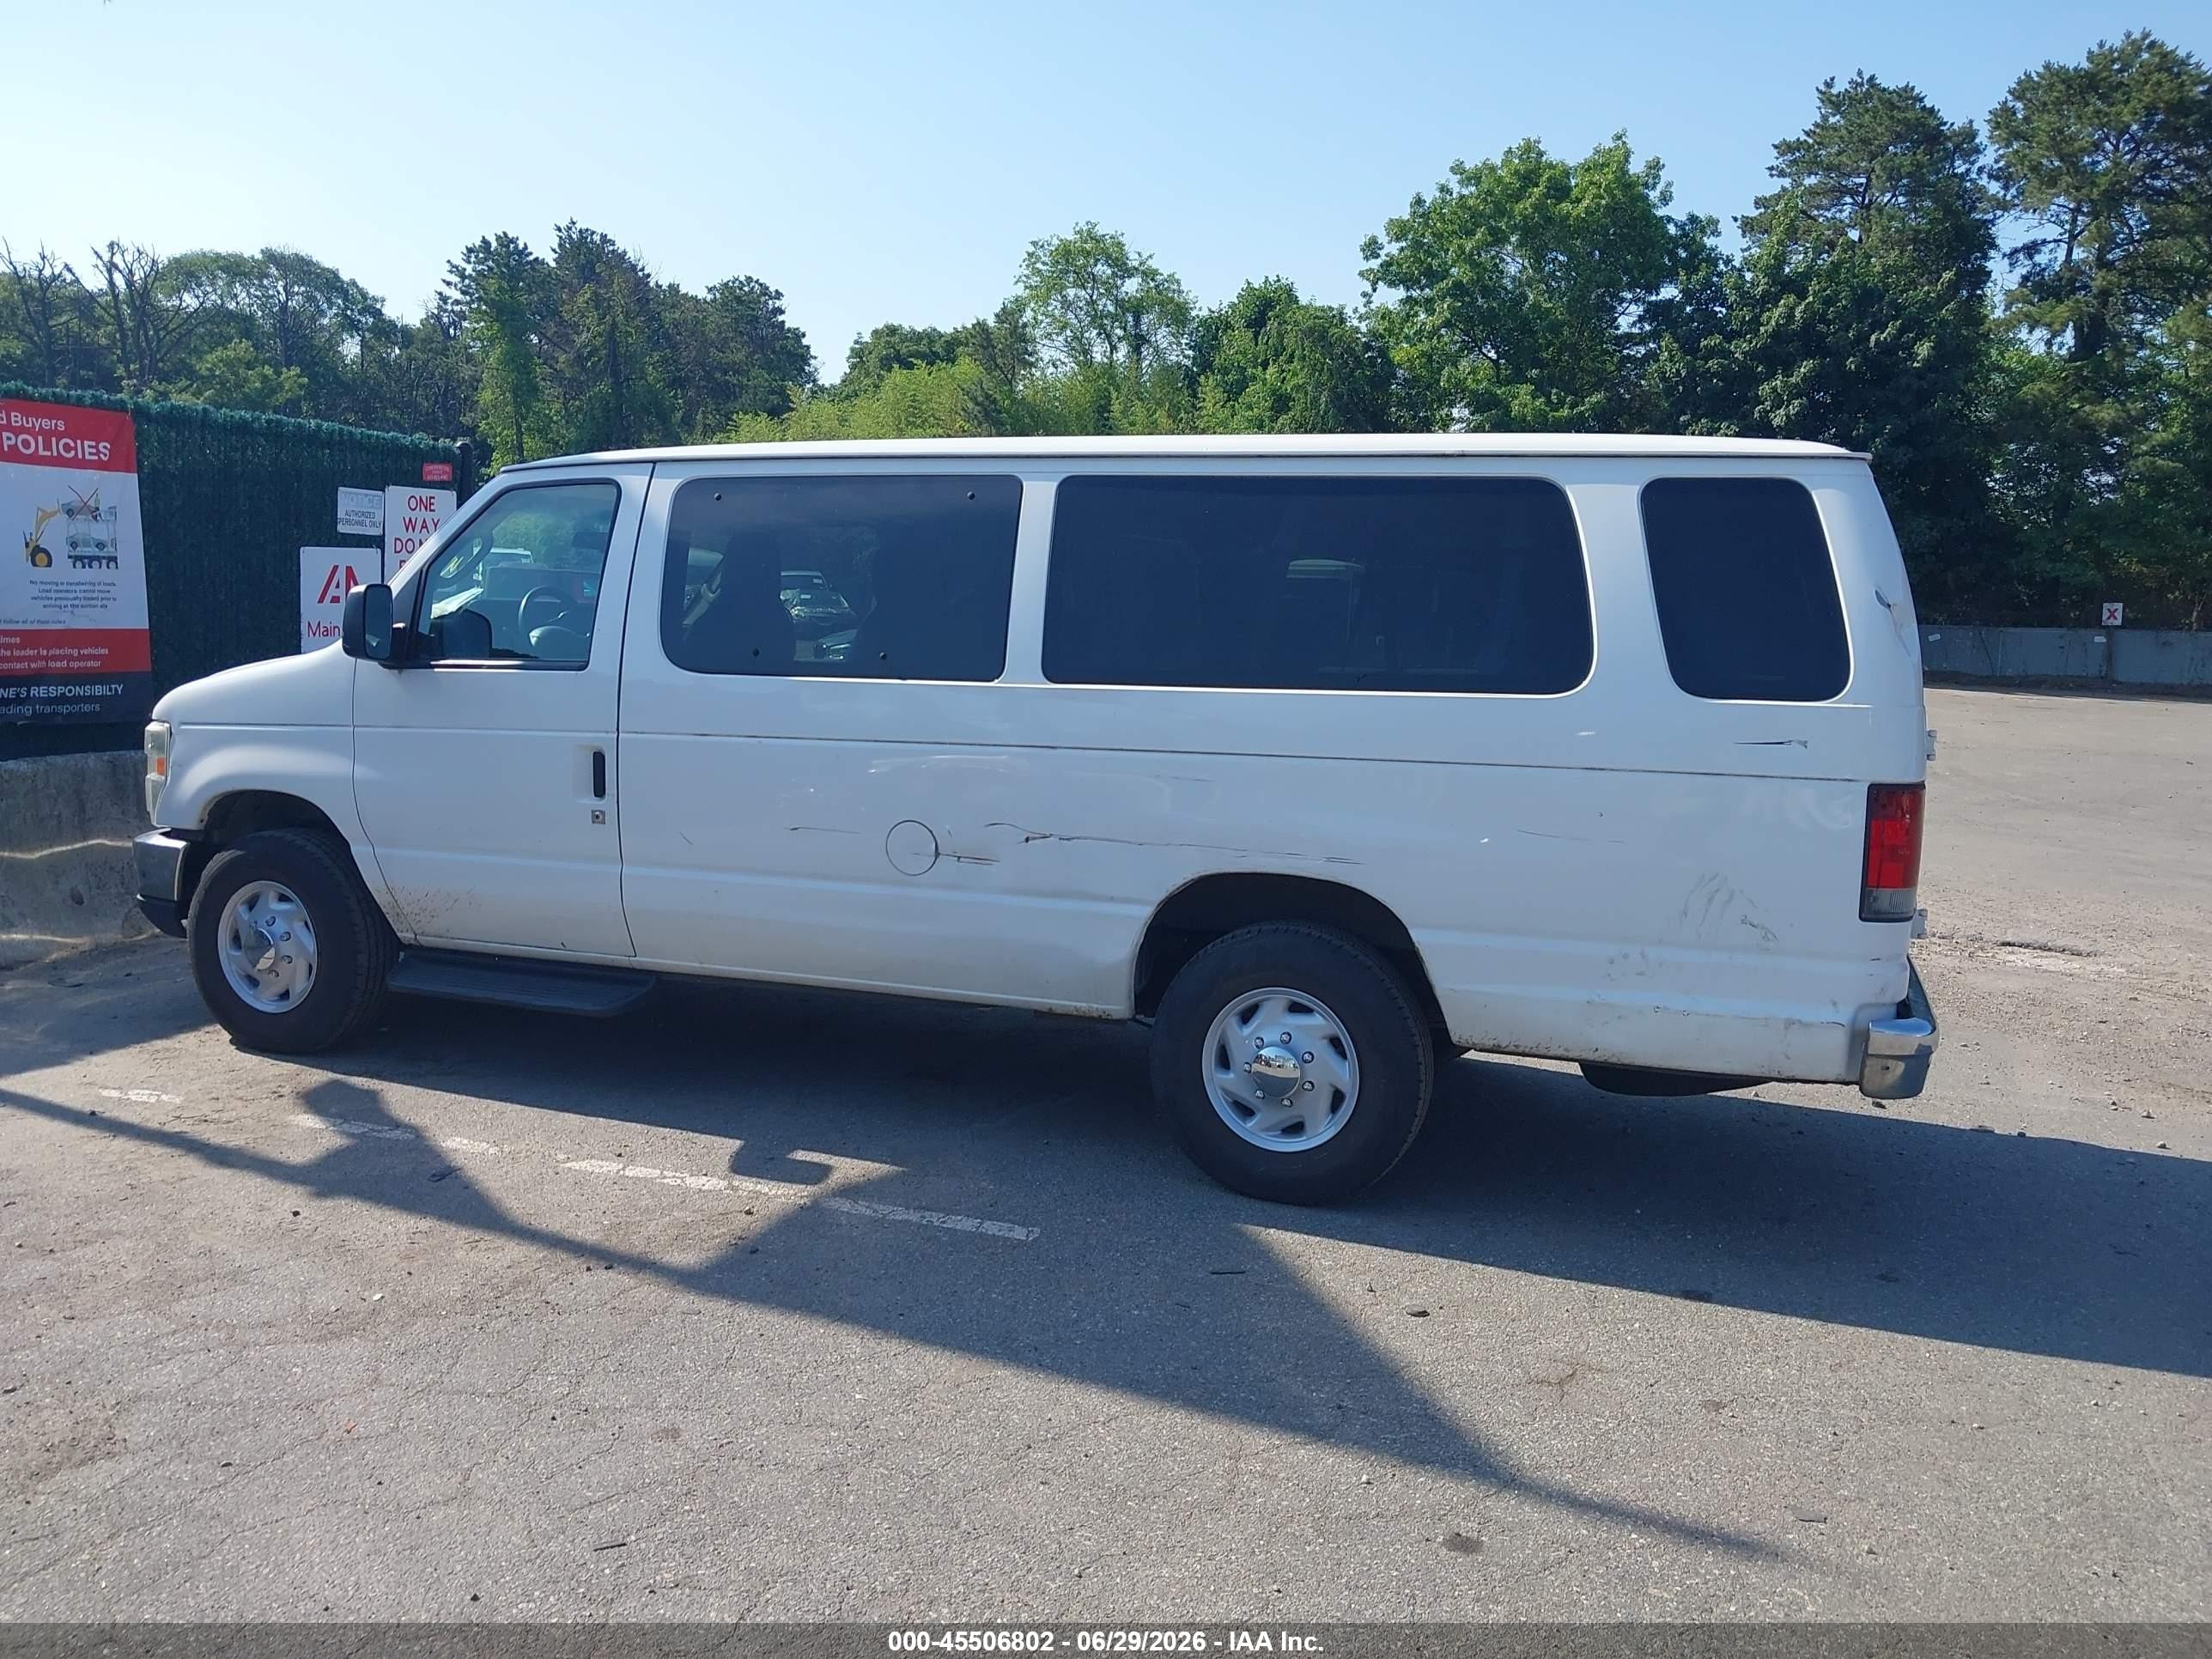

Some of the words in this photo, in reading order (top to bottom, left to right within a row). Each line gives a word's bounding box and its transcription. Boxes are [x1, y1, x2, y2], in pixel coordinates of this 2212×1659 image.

[10, 411, 66, 432] Buyers
[2, 431, 112, 461] POLICIES
[340, 493, 380, 508] NOTICE
[407, 495, 436, 513] ONE
[344, 508, 376, 520] AUTHORIZED
[337, 517, 368, 528] PERSONNEL
[369, 520, 382, 529] ONLY
[402, 516, 441, 534] WAY
[307, 620, 341, 638] Main
[0, 635, 21, 644] imes
[0, 647, 12, 658] he
[13, 647, 38, 657] loader
[40, 647, 48, 656] is
[48, 647, 78, 658] placing
[80, 646, 109, 655] vehicles
[0, 660, 28, 670] contact
[29, 659, 46, 669] with
[69, 659, 101, 670] operator
[0, 687, 28, 699] NE'S
[36, 702, 101, 715] transporters
